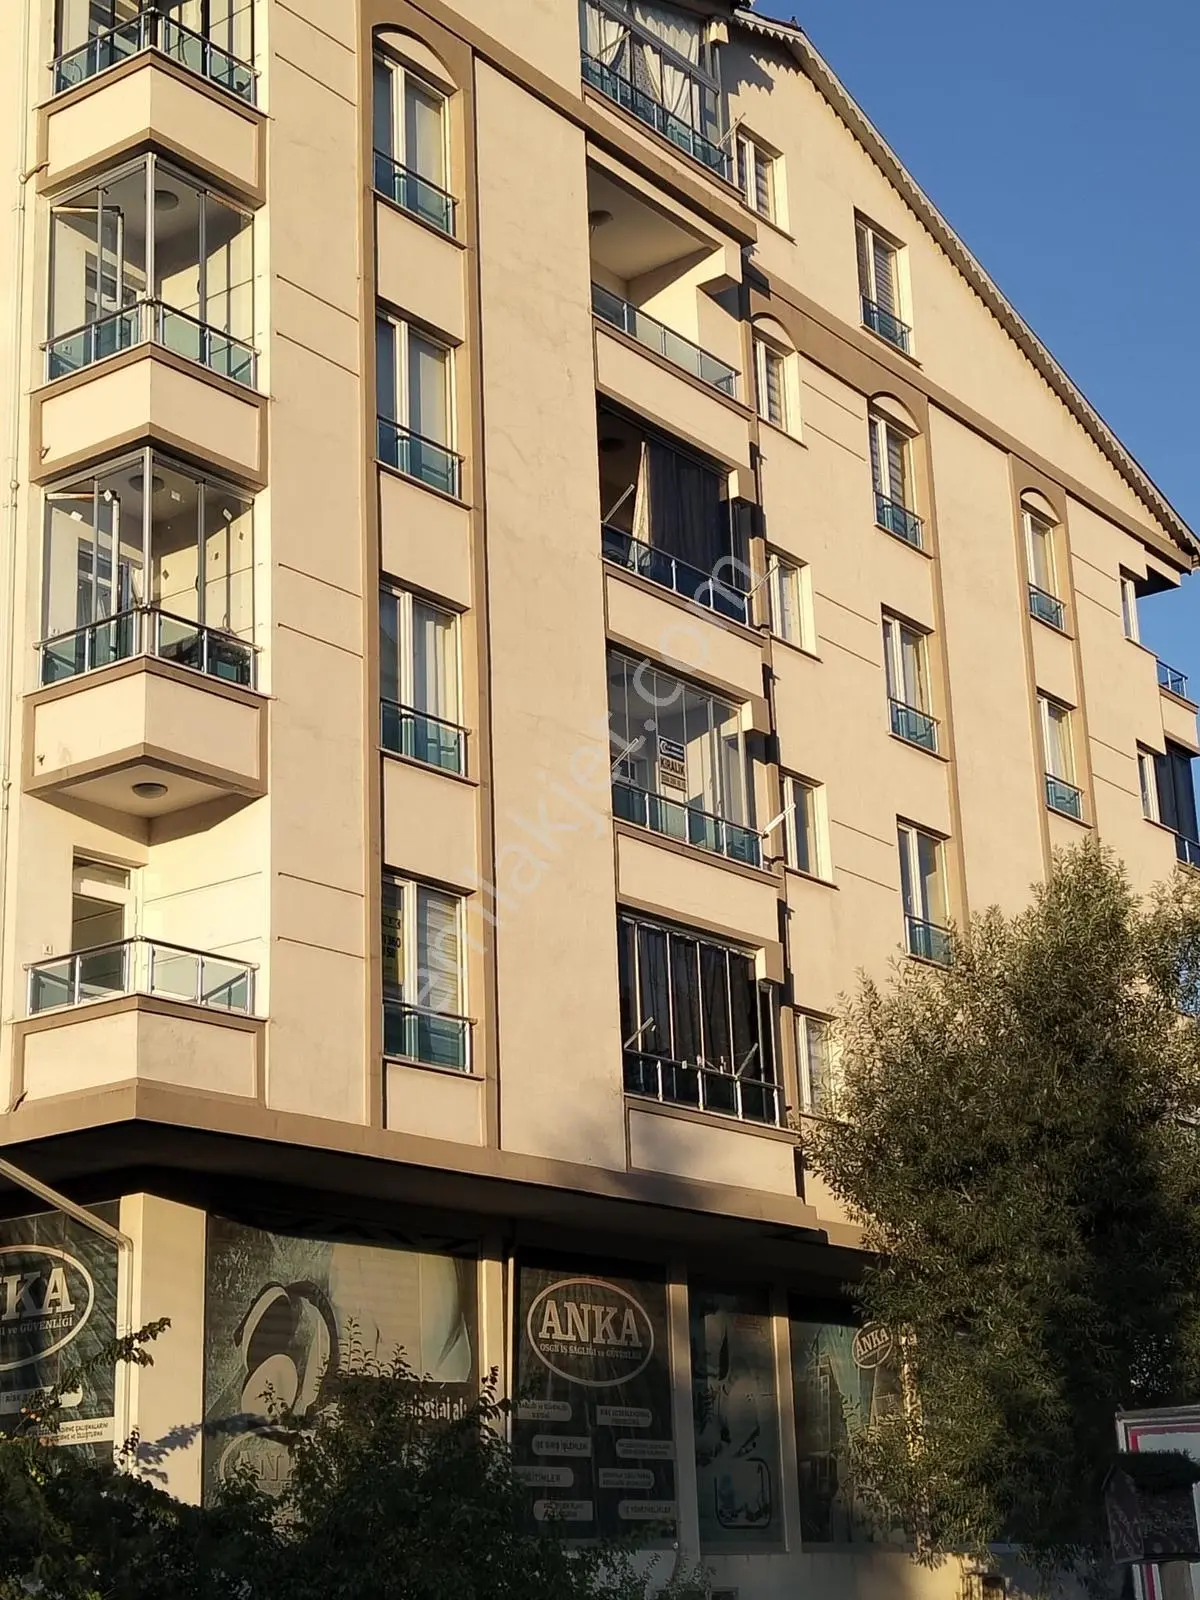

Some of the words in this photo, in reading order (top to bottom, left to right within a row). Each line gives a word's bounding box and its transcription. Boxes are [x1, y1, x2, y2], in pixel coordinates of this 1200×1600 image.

[0, 1267, 75, 1320] KA
[538, 1299, 643, 1348] ANKA
[856, 1328, 890, 1358] ANKA
